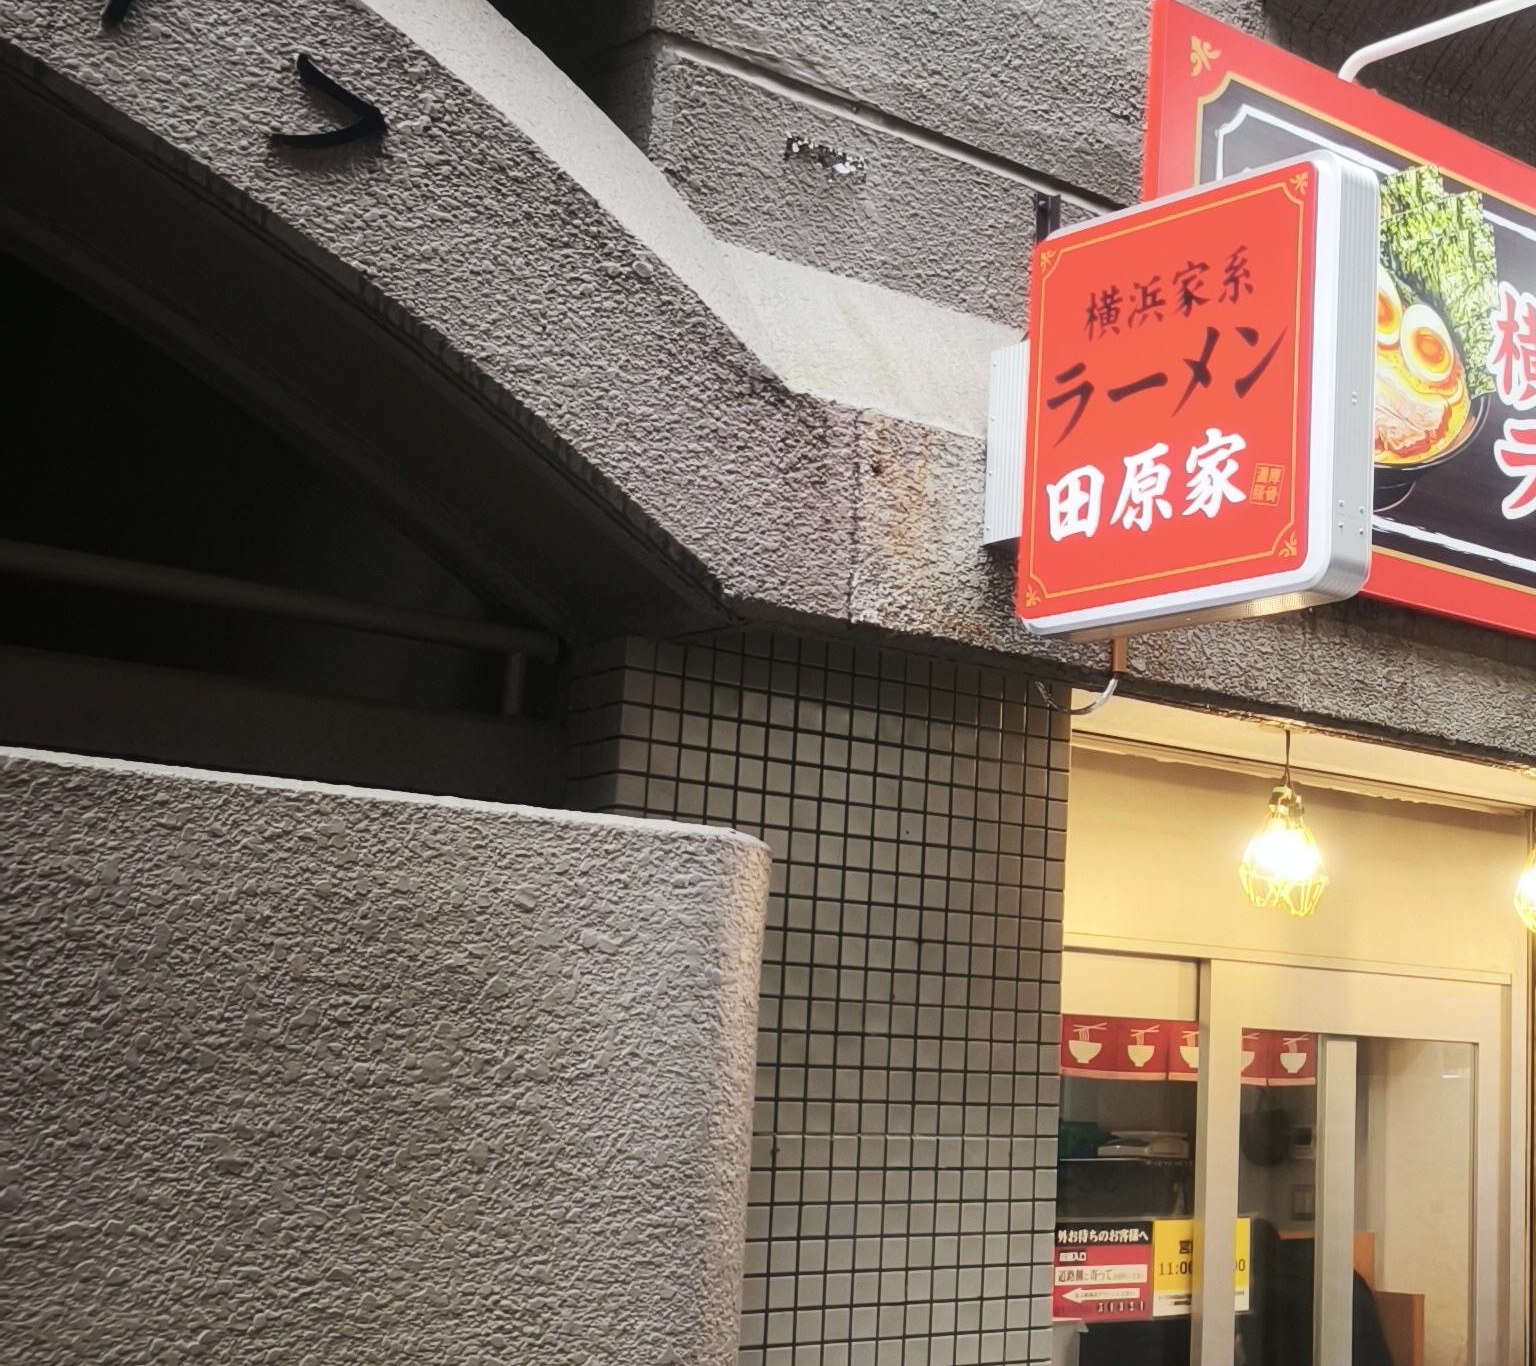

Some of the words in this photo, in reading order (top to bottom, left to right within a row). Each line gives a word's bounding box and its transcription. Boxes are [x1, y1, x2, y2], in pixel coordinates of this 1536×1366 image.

[1084, 245, 1255, 342] 横浜家系
[1046, 323, 1287, 449] ラーメン
[1045, 428, 1247, 541] 田原家
